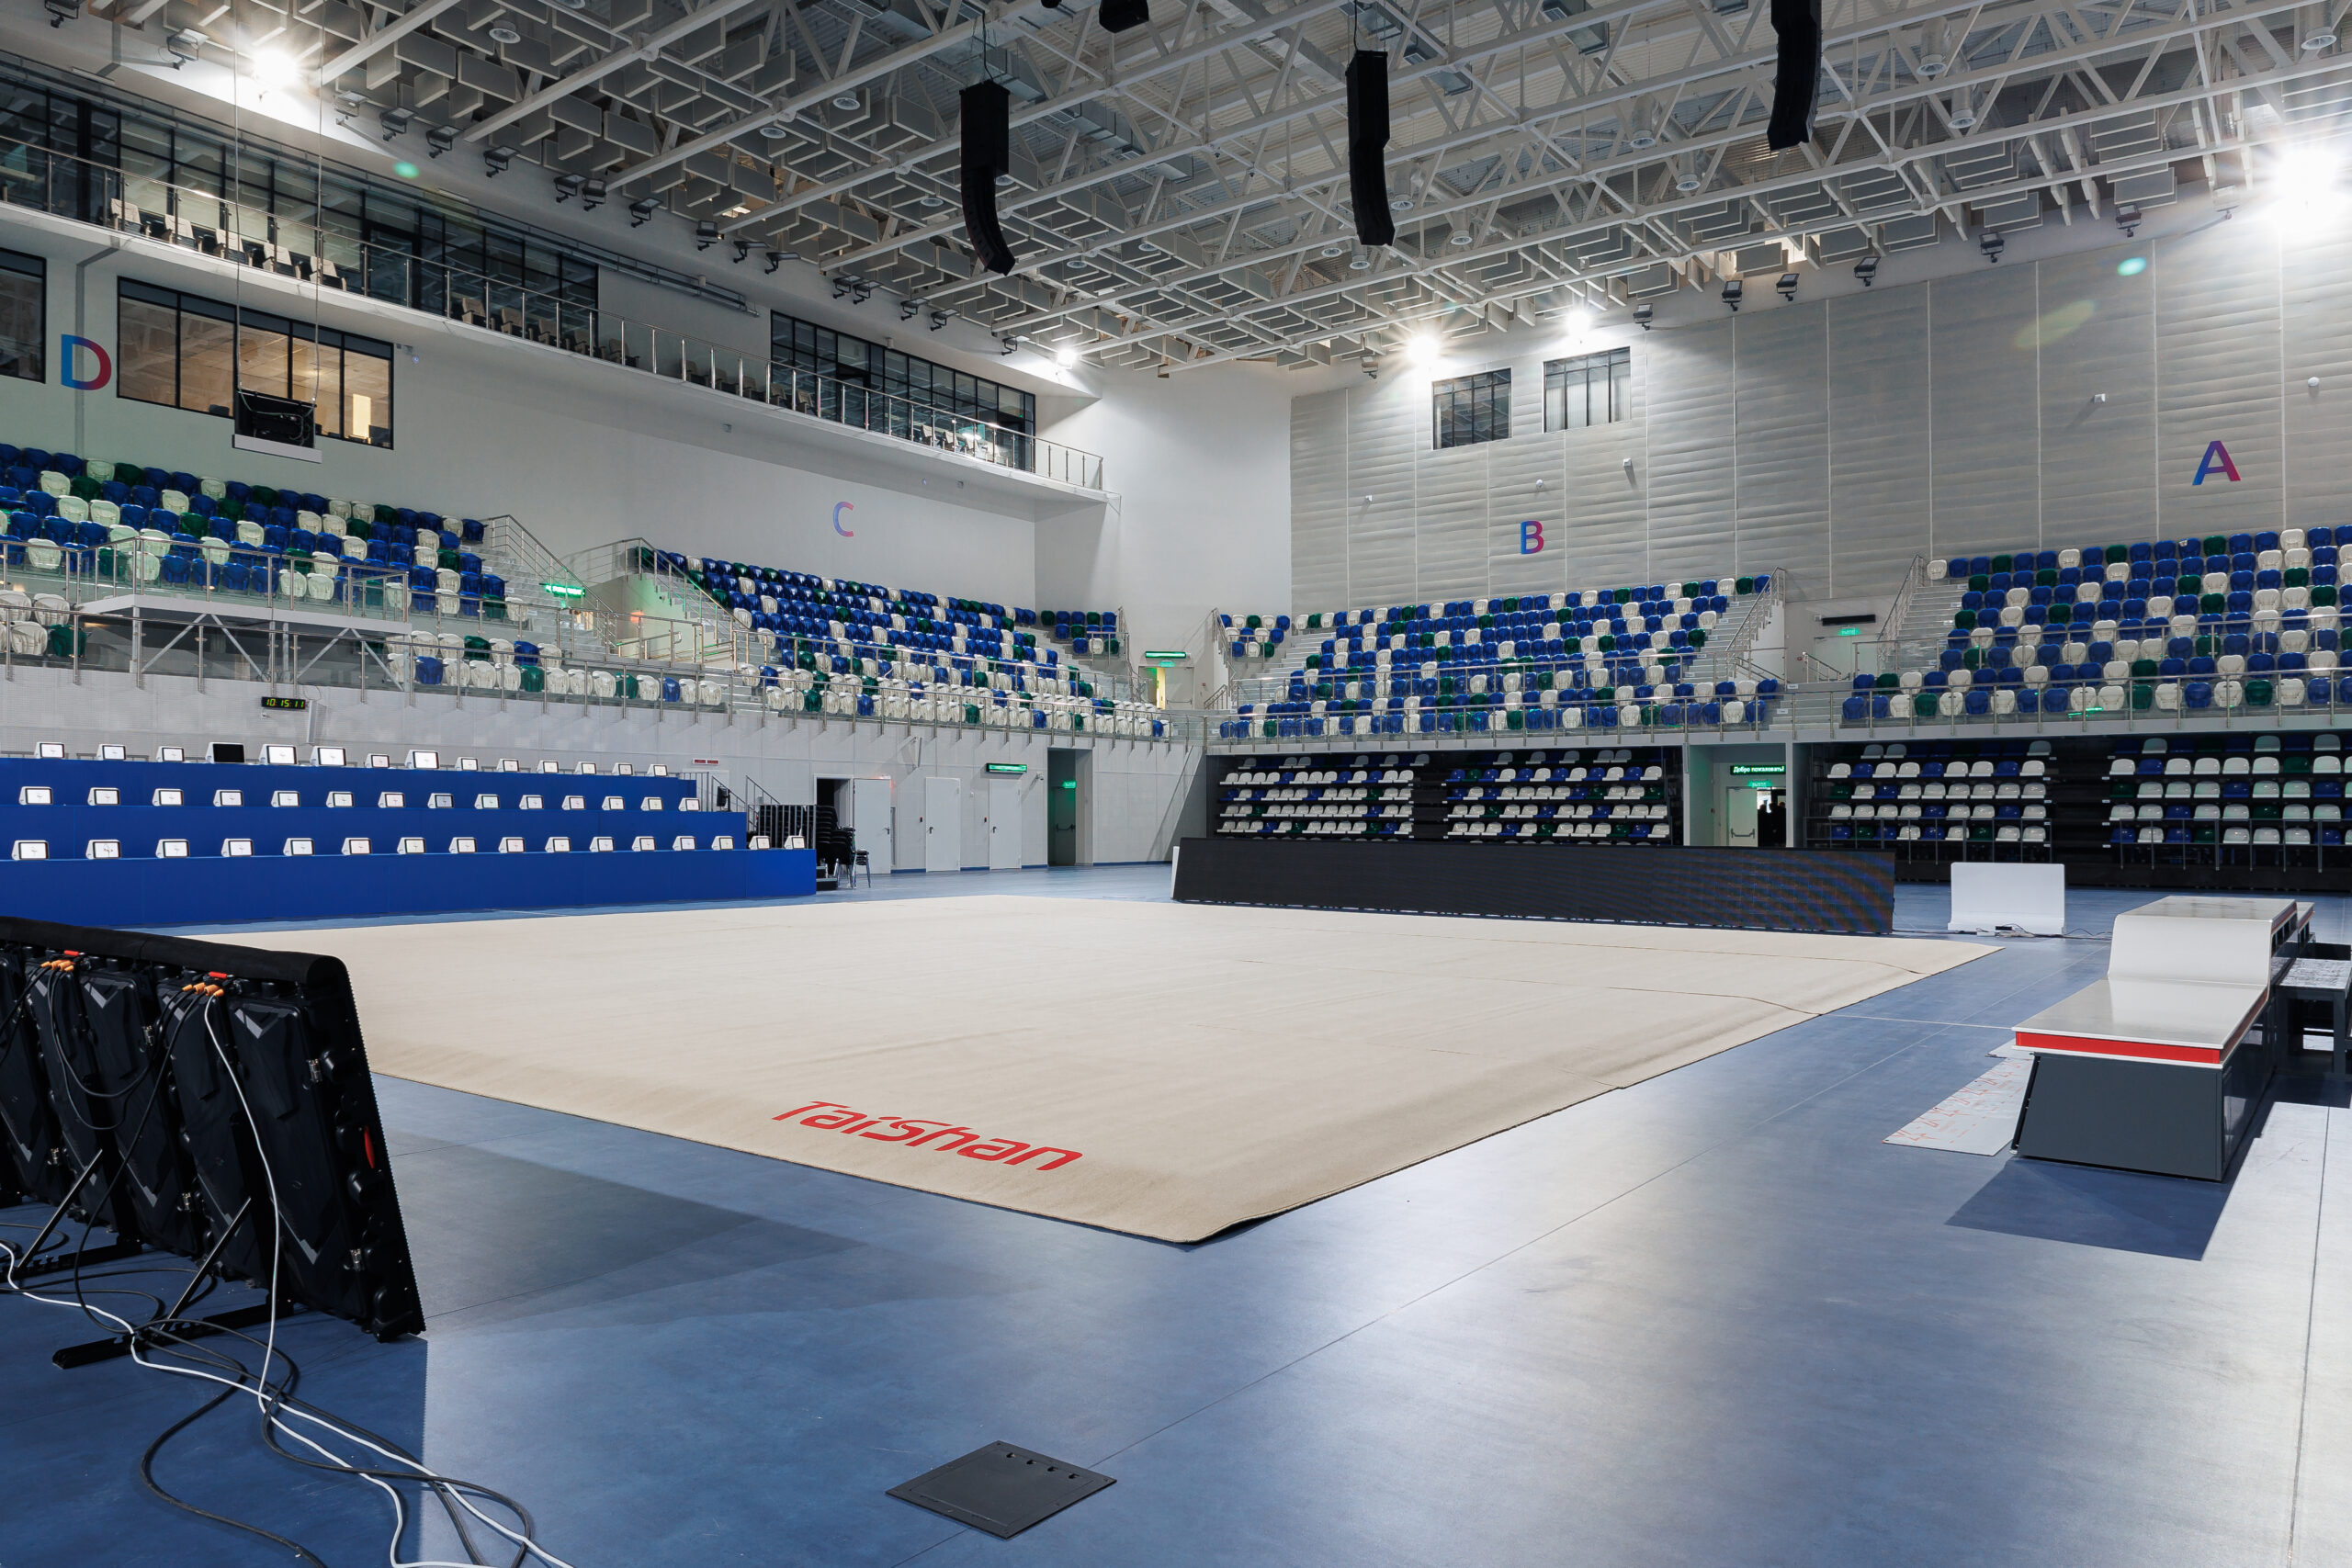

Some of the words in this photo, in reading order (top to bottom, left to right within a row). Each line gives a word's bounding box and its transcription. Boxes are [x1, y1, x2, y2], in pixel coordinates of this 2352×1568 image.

[61, 333, 112, 390] D
[2192, 440, 2242, 486] A
[832, 501, 855, 538] C
[1520, 520, 1544, 555] B
